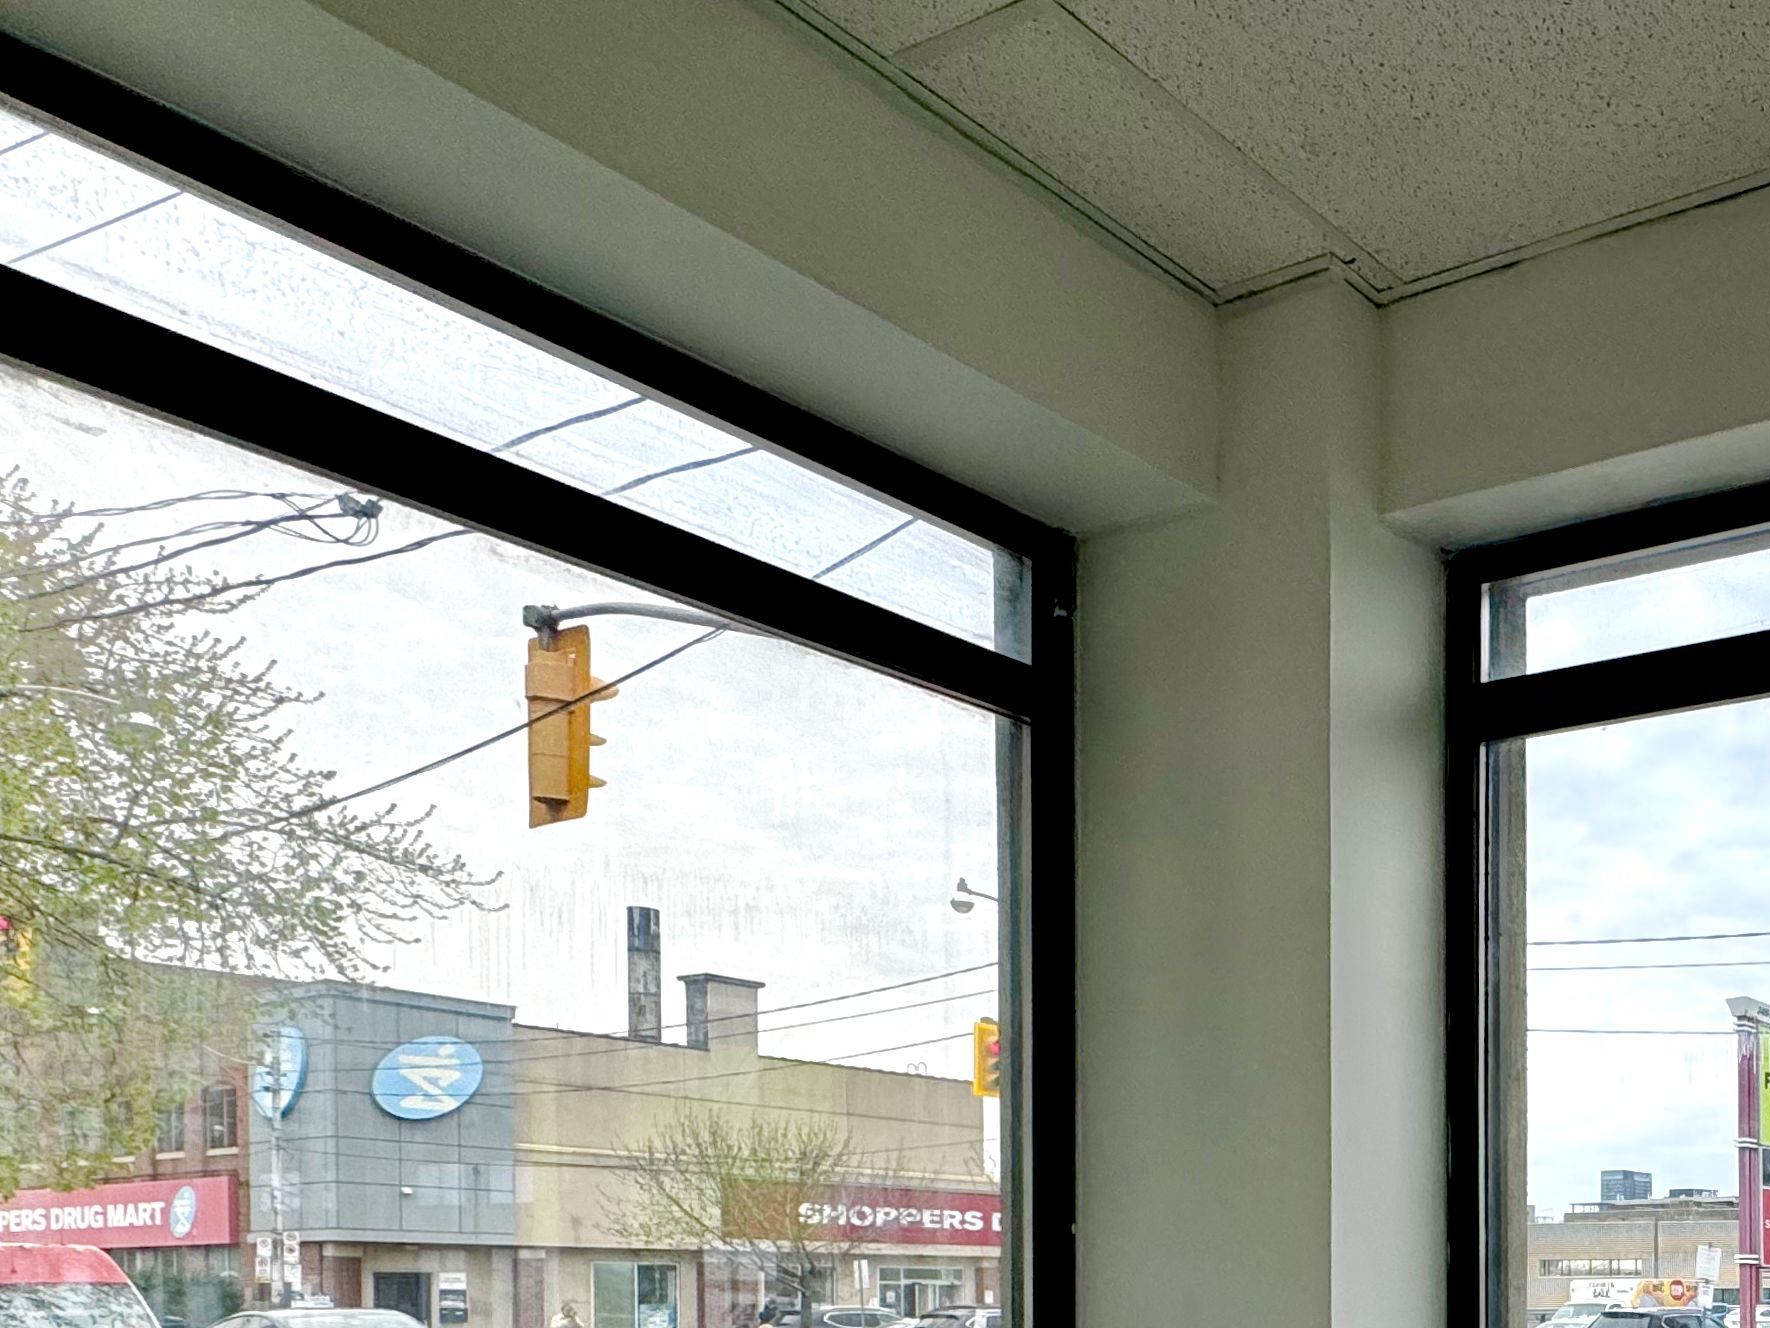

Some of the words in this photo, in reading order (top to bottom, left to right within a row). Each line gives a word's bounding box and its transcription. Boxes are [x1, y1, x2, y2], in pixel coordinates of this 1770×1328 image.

[50, 1204, 105, 1231] DRUG
[106, 1201, 166, 1228] MART
[798, 1202, 984, 1231] SHOPPERS
